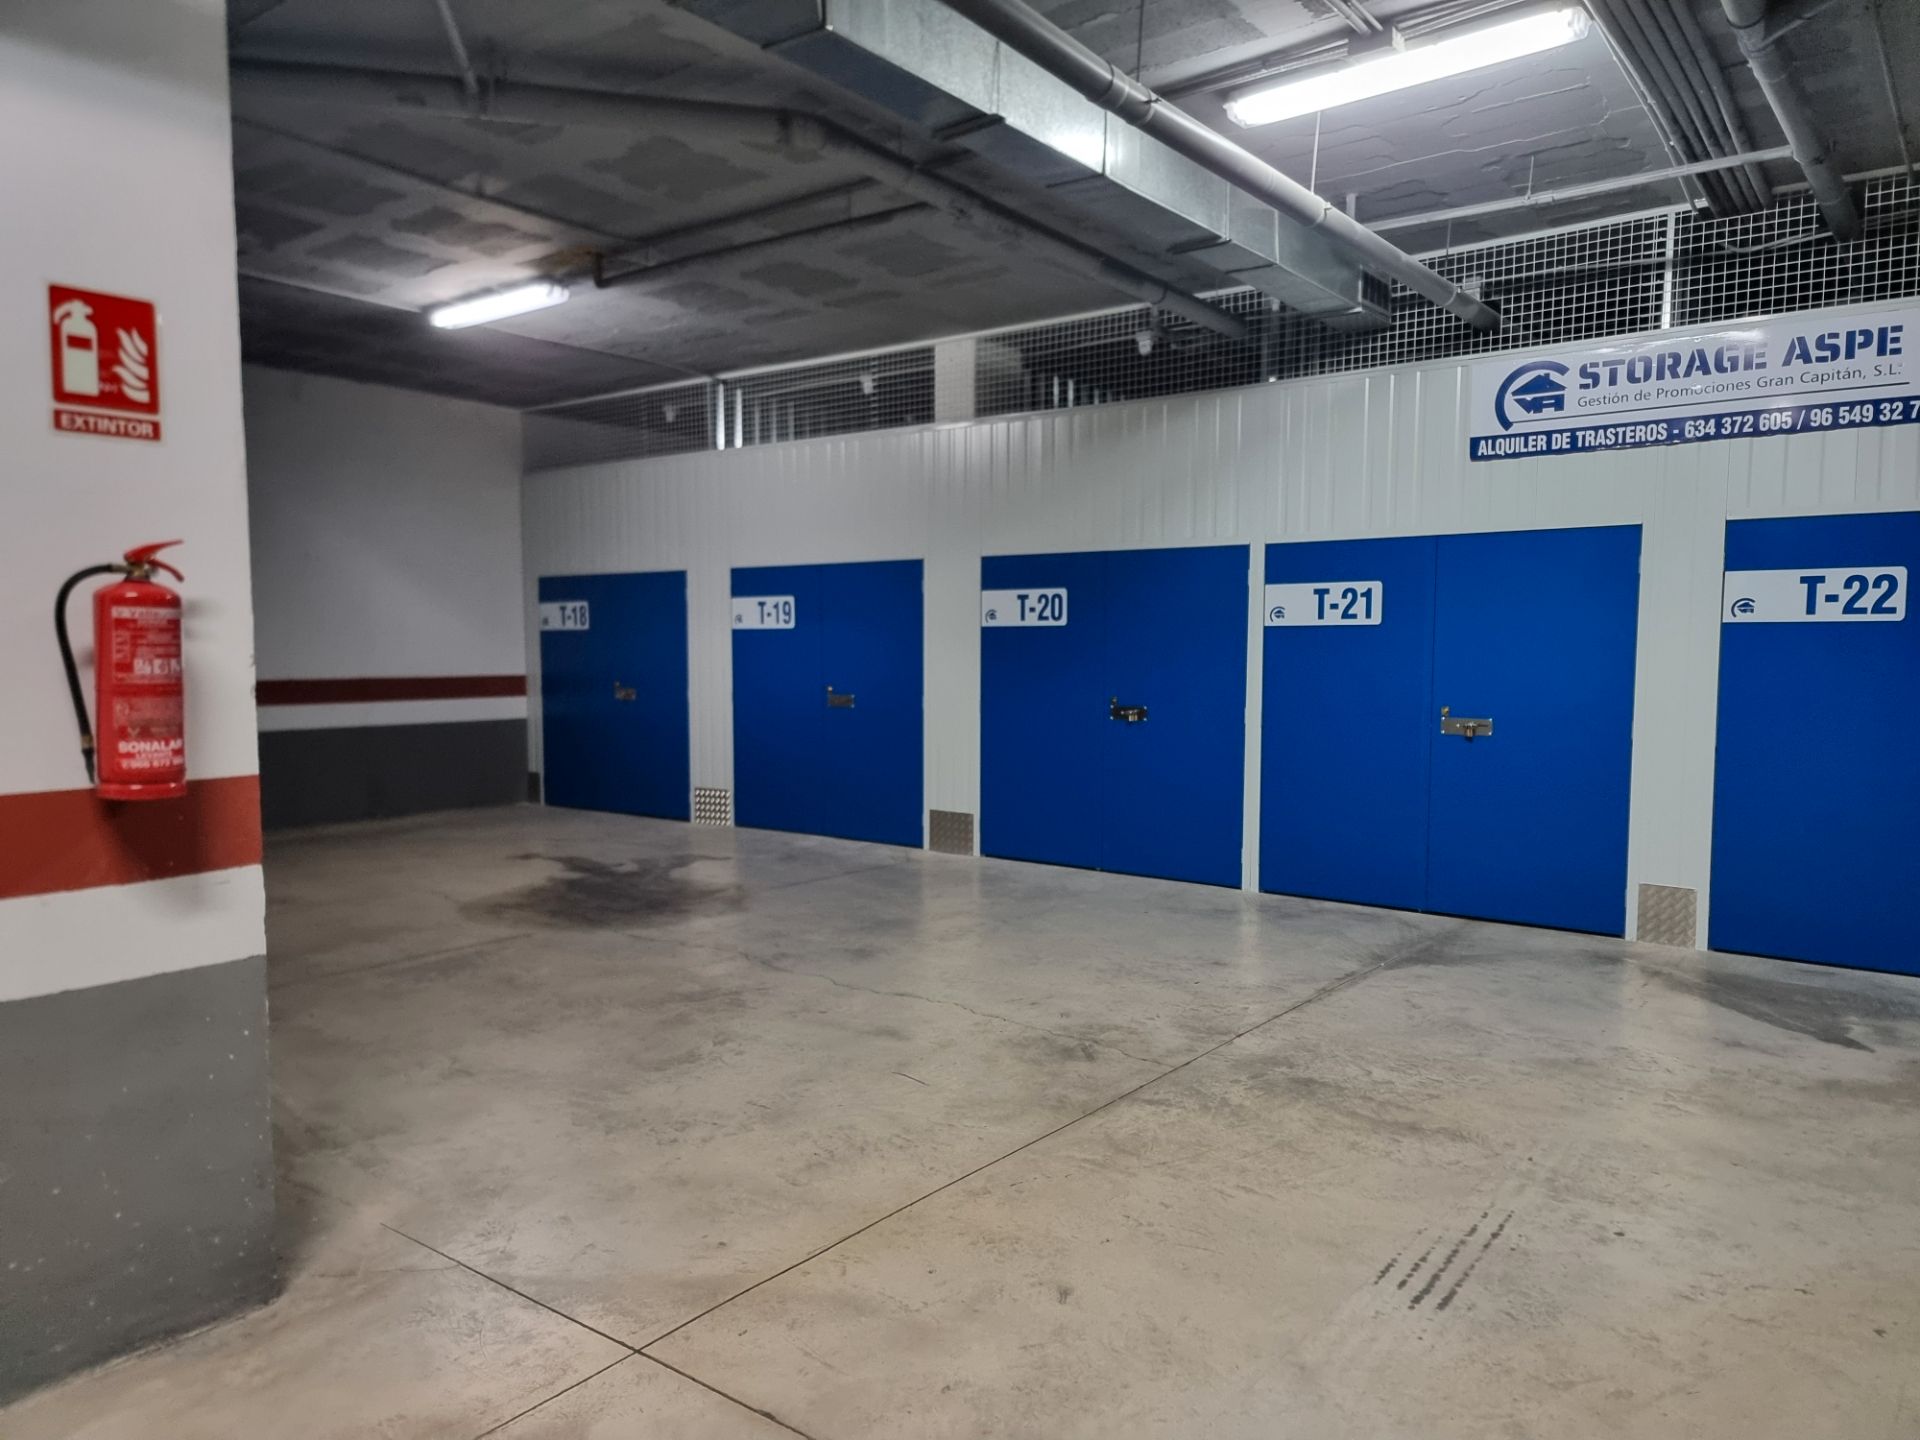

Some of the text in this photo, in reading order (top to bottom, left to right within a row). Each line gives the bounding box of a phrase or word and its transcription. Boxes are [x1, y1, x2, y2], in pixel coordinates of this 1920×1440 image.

[1579, 325, 1904, 390] STORAGE ASPE
[1577, 364, 1902, 408] Gestión de Promociones Gran Capitán, S.L.
[60, 412, 154, 438] EXTINTOR
[1477, 434, 1547, 457] ALQUILER
[1552, 432, 1571, 449] DE
[1576, 423, 1668, 447] TRASTEROS
[1684, 418, 1716, 438] 634
[1721, 415, 1754, 434] 372
[1759, 411, 1792, 431] 605
[1797, 410, 1807, 429] /
[1810, 408, 1833, 427] 96
[1838, 404, 1874, 424] 549
[1879, 401, 1904, 421] 32
[1016, 594, 1064, 622] T-20
[1313, 587, 1373, 620] T-21
[1800, 573, 1899, 616] T-22
[559, 605, 587, 627] T-18
[757, 600, 792, 625] T-19
